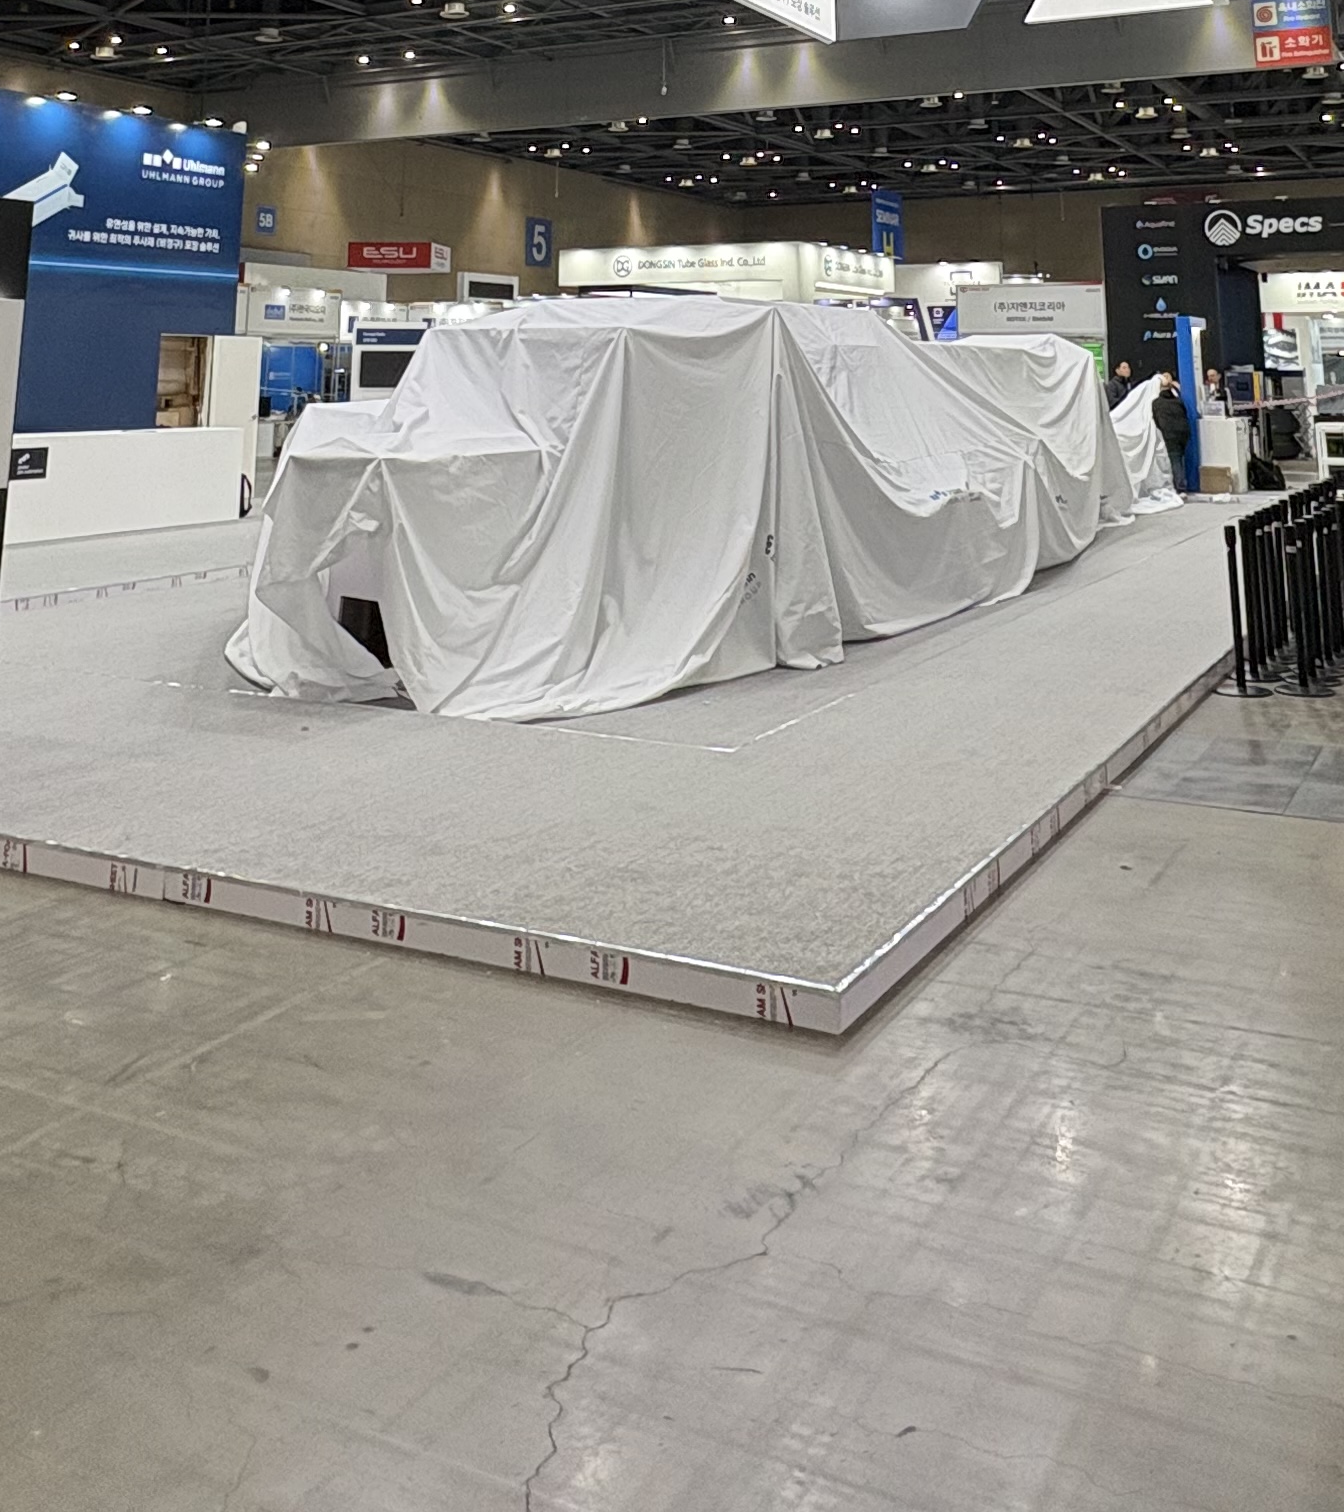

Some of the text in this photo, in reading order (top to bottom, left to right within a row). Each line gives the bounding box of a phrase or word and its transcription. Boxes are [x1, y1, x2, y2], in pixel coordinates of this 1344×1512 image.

[1278, 0, 1326, 12] 옥내소화전
[1284, 34, 1324, 48] 소화기
[183, 159, 225, 176] Uhlmann
[142, 169, 225, 188] UHLMANN GROUP
[259, 212, 273, 228] 5B
[1245, 214, 1323, 238] Specs
[532, 225, 546, 262] 5
[363, 247, 416, 258] ESU
[677, 258, 696, 268] Tube
[698, 257, 718, 268] Glass
